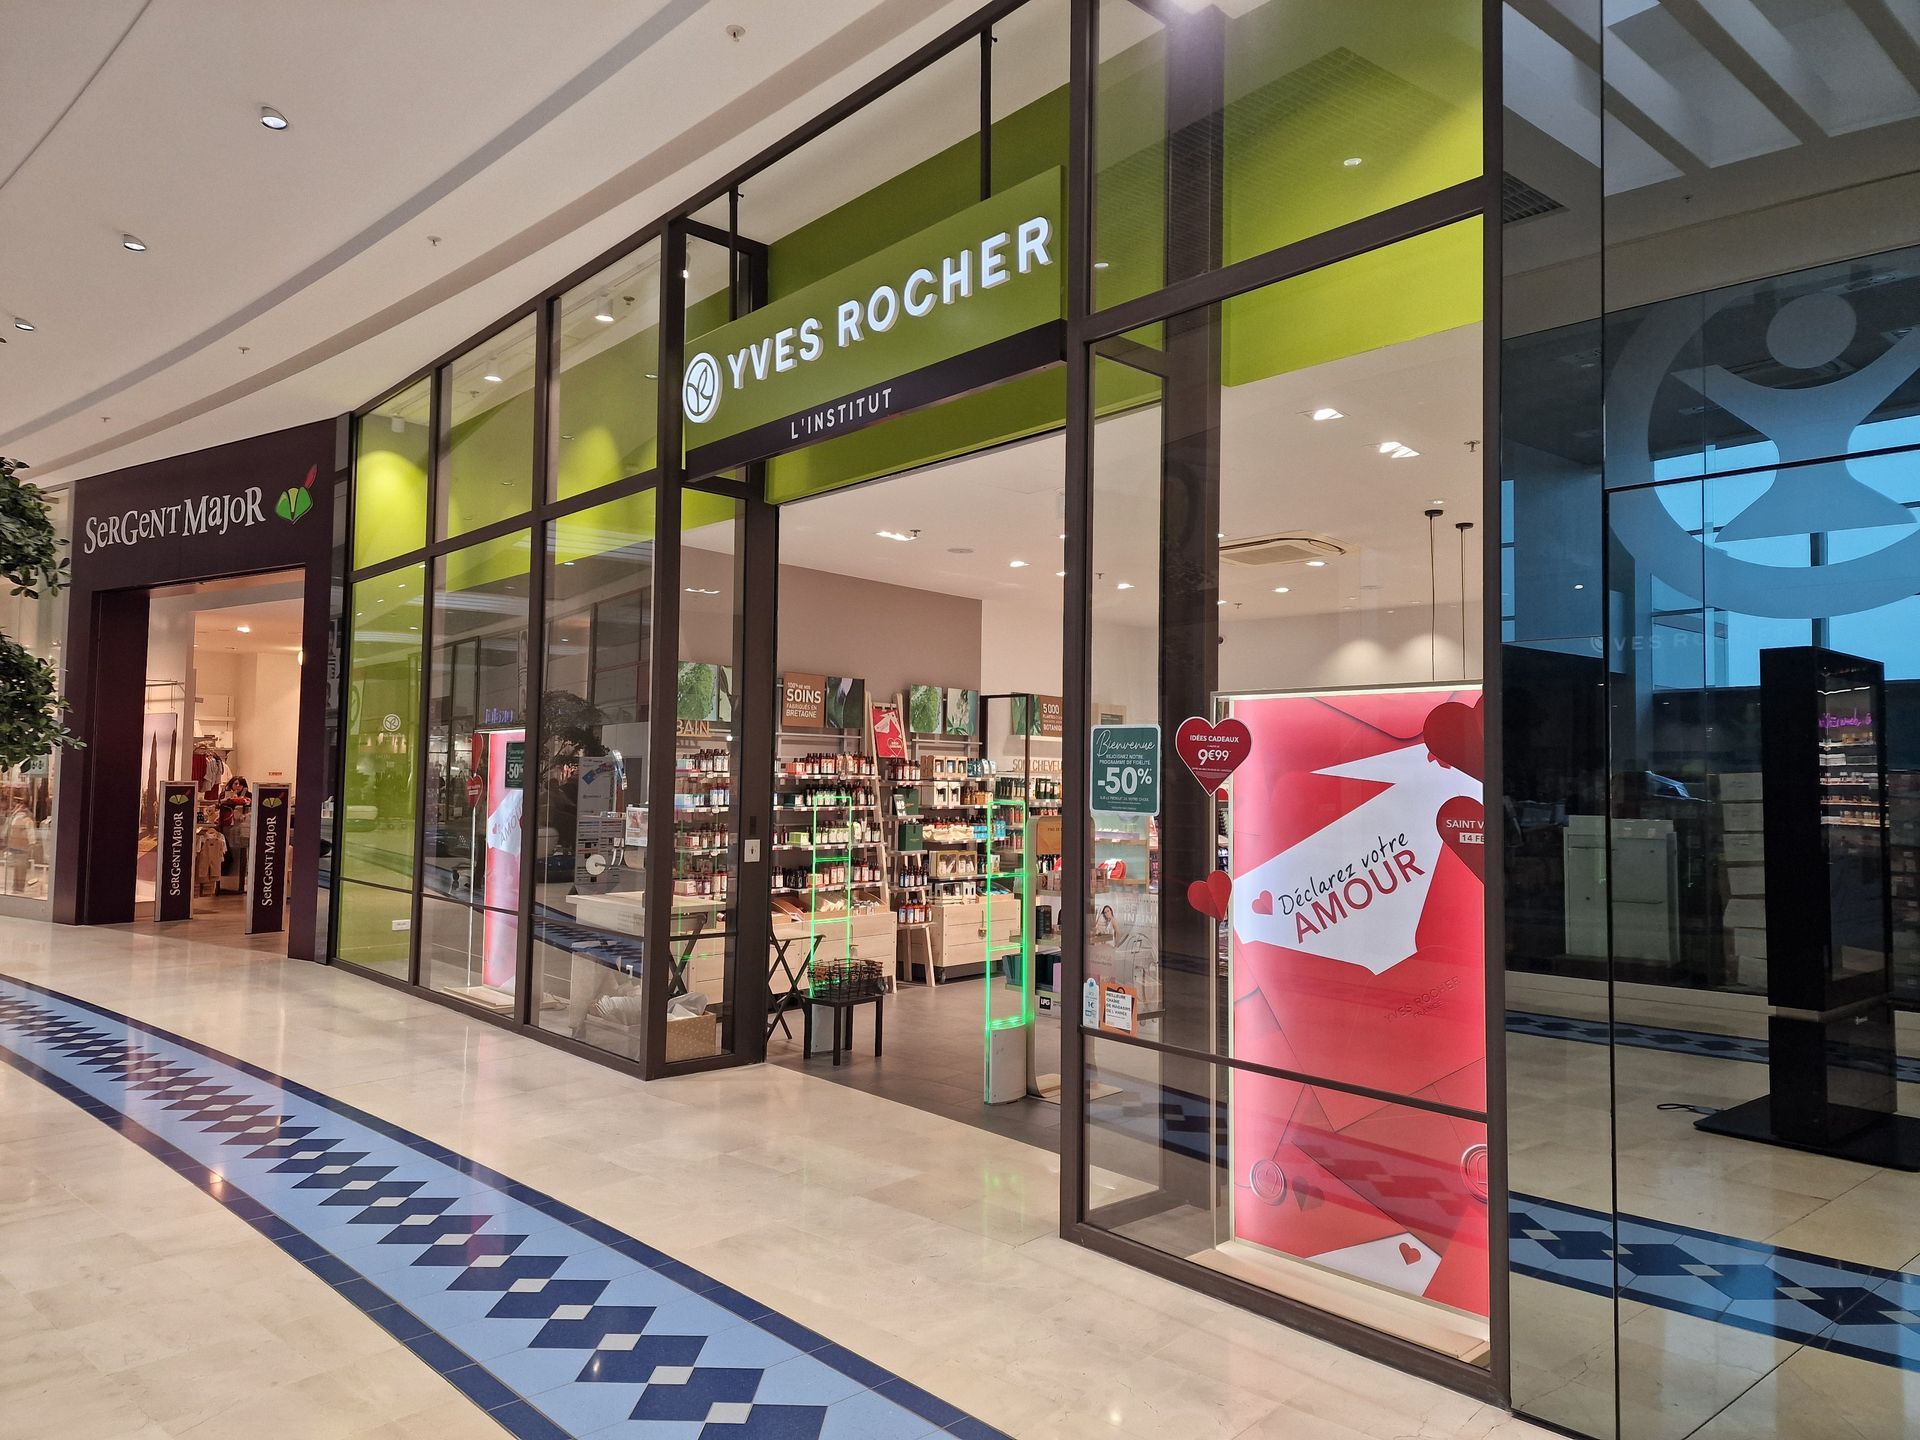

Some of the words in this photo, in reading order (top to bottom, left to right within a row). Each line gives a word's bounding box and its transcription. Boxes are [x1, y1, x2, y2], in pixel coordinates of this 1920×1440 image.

[727, 317, 824, 389] YVES
[837, 216, 1053, 347] ROCHER
[791, 387, 893, 440] L'INSTITUT
[786, 688, 821, 704] SOINS
[786, 709, 817, 718] BRETAGNE
[1096, 729, 1156, 757] Bienvenue
[1208, 735, 1240, 743] CADEAUX
[1446, 819, 1476, 829] SAINT
[1462, 834, 1473, 842] 14
[1278, 863, 1357, 916] Déclarez
[1361, 832, 1408, 870] votre
[1294, 849, 1425, 944] AMOUR
